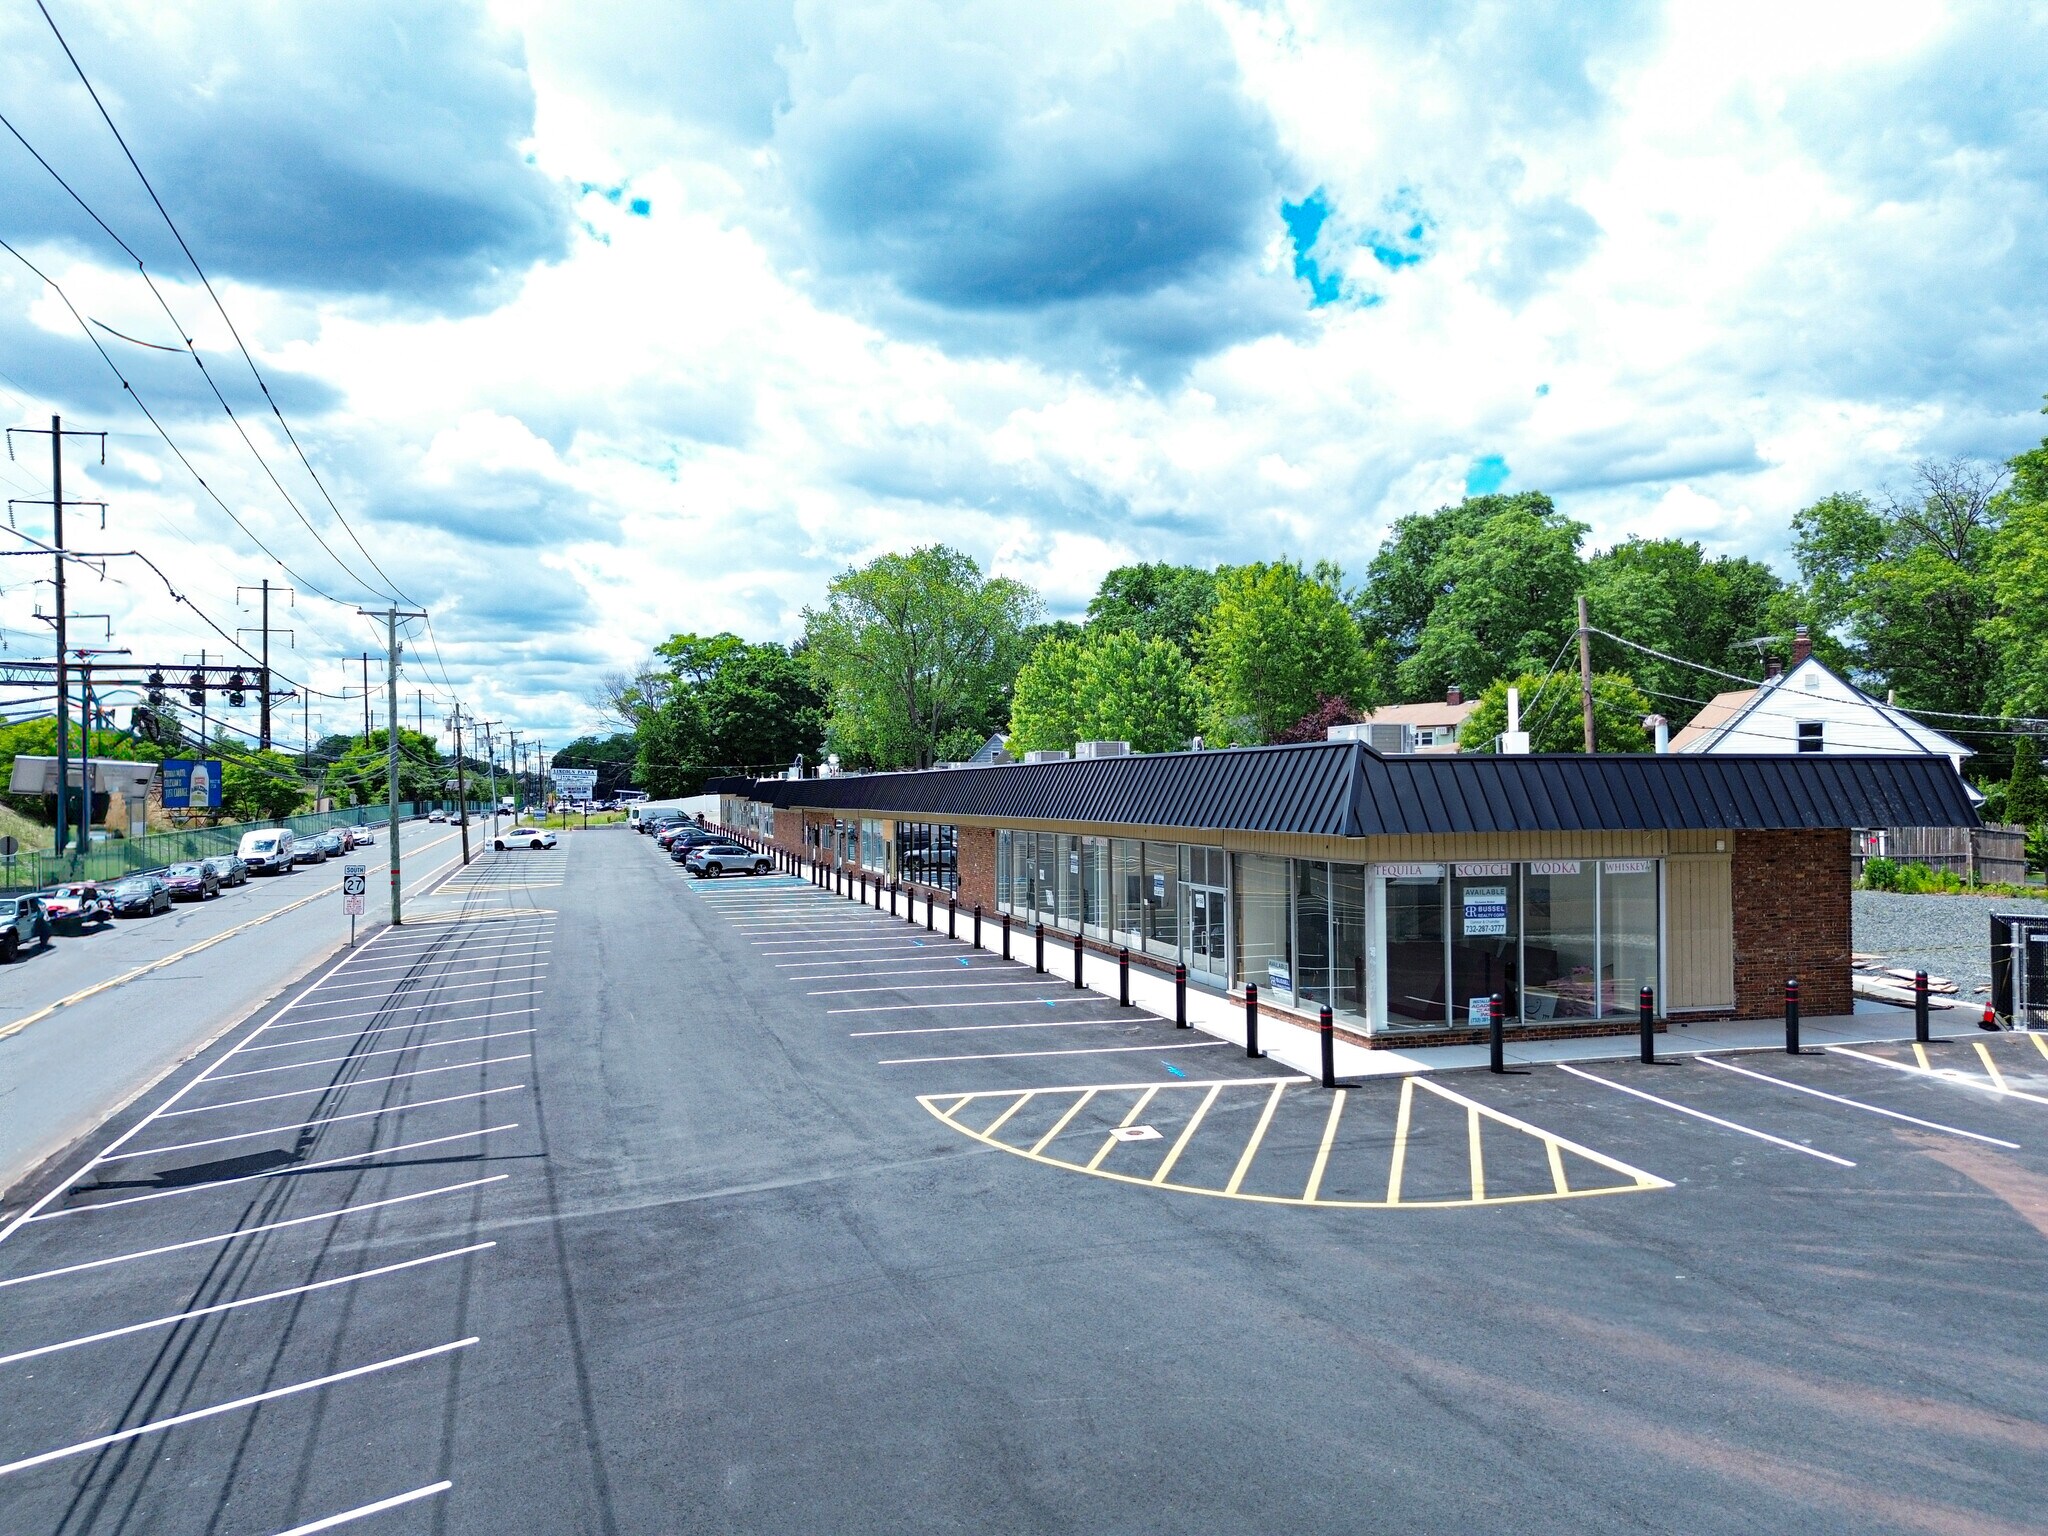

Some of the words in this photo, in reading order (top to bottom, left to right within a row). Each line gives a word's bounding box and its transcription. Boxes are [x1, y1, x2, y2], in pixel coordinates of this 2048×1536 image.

[1375, 864, 1422, 878] TEQUILA
[1457, 864, 1509, 876] SCOTCH
[1533, 862, 1577, 874] VODKA
[1606, 862, 1646, 872] WHISKEY
[347, 880, 362, 890] 27
